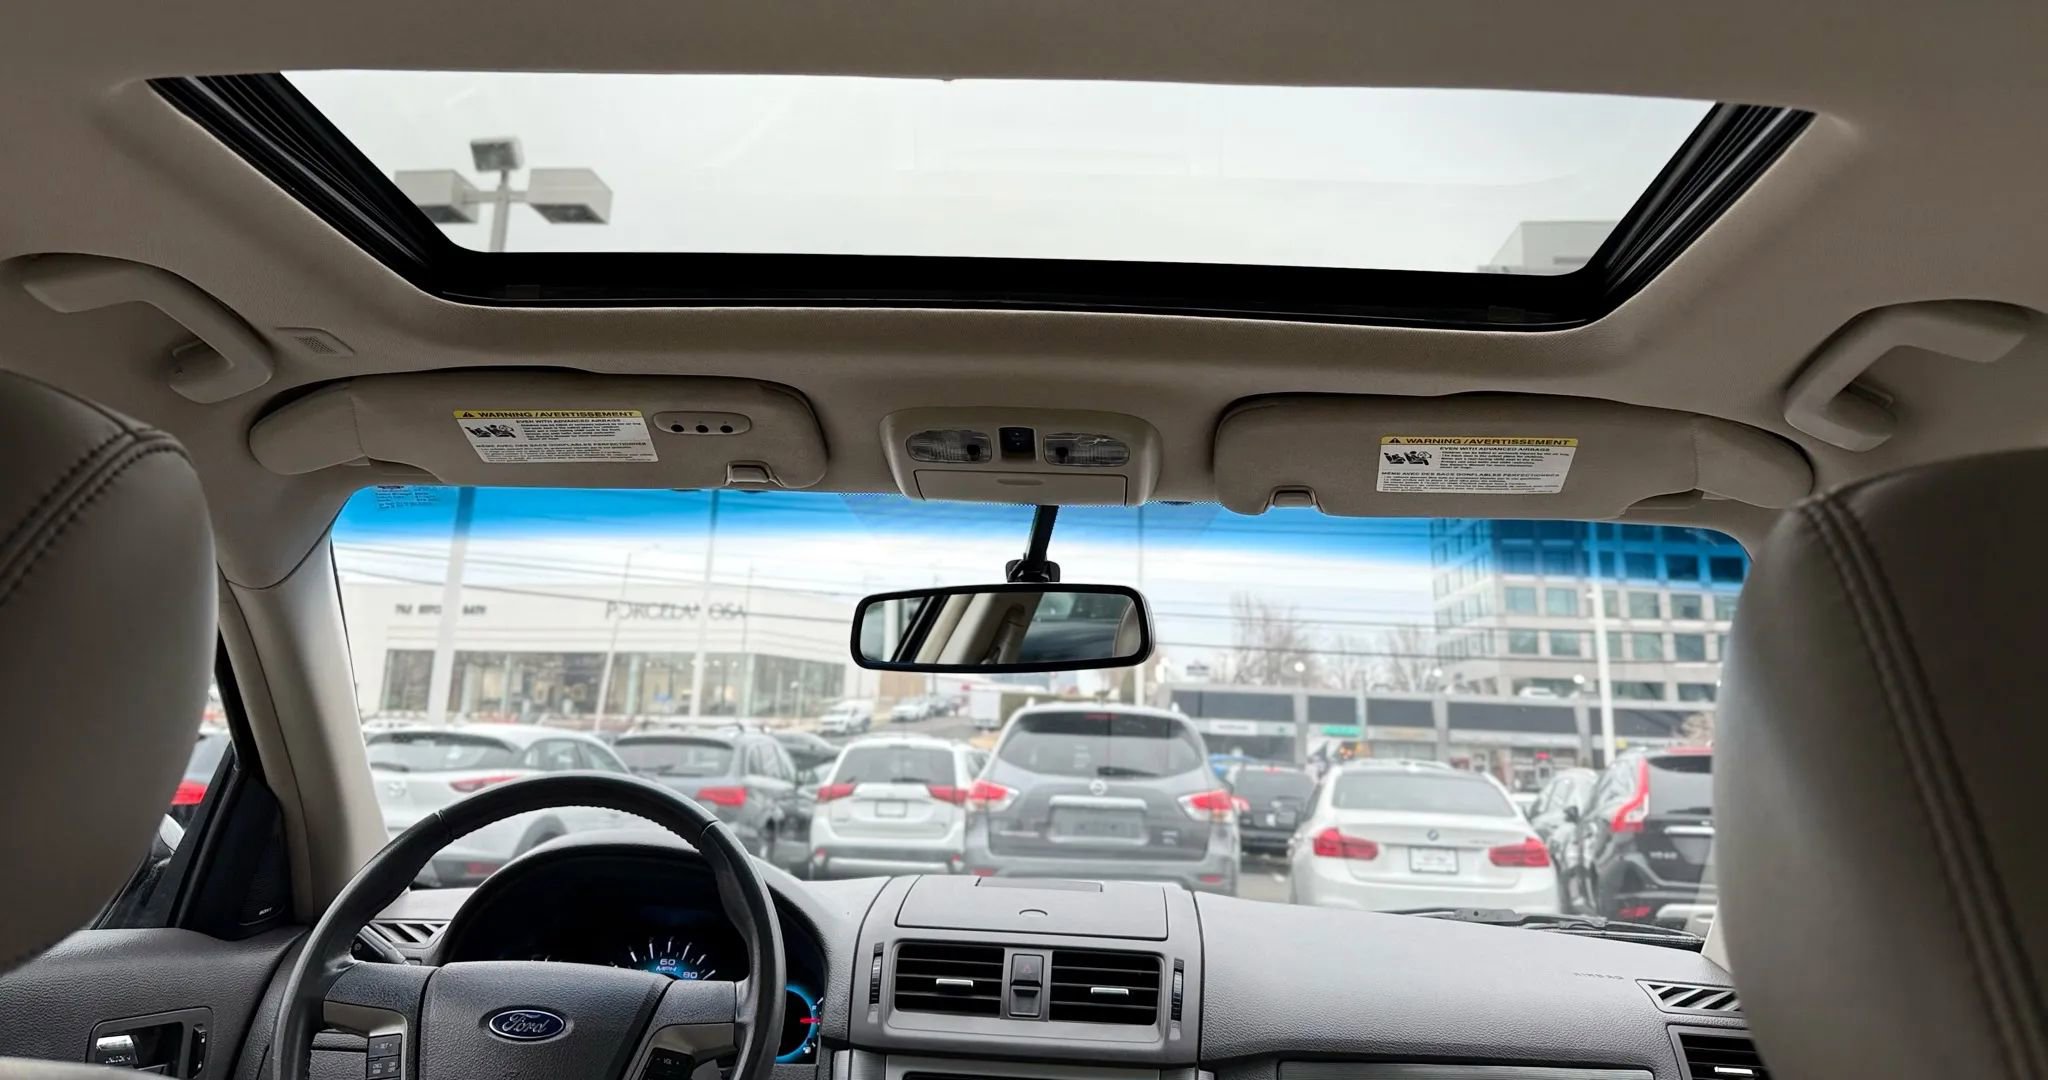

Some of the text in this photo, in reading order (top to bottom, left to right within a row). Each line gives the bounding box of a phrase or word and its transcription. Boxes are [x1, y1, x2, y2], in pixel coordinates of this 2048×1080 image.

[659, 958, 676, 966] 60
[682, 971, 698, 979] 80
[502, 1012, 550, 1033] Ford
